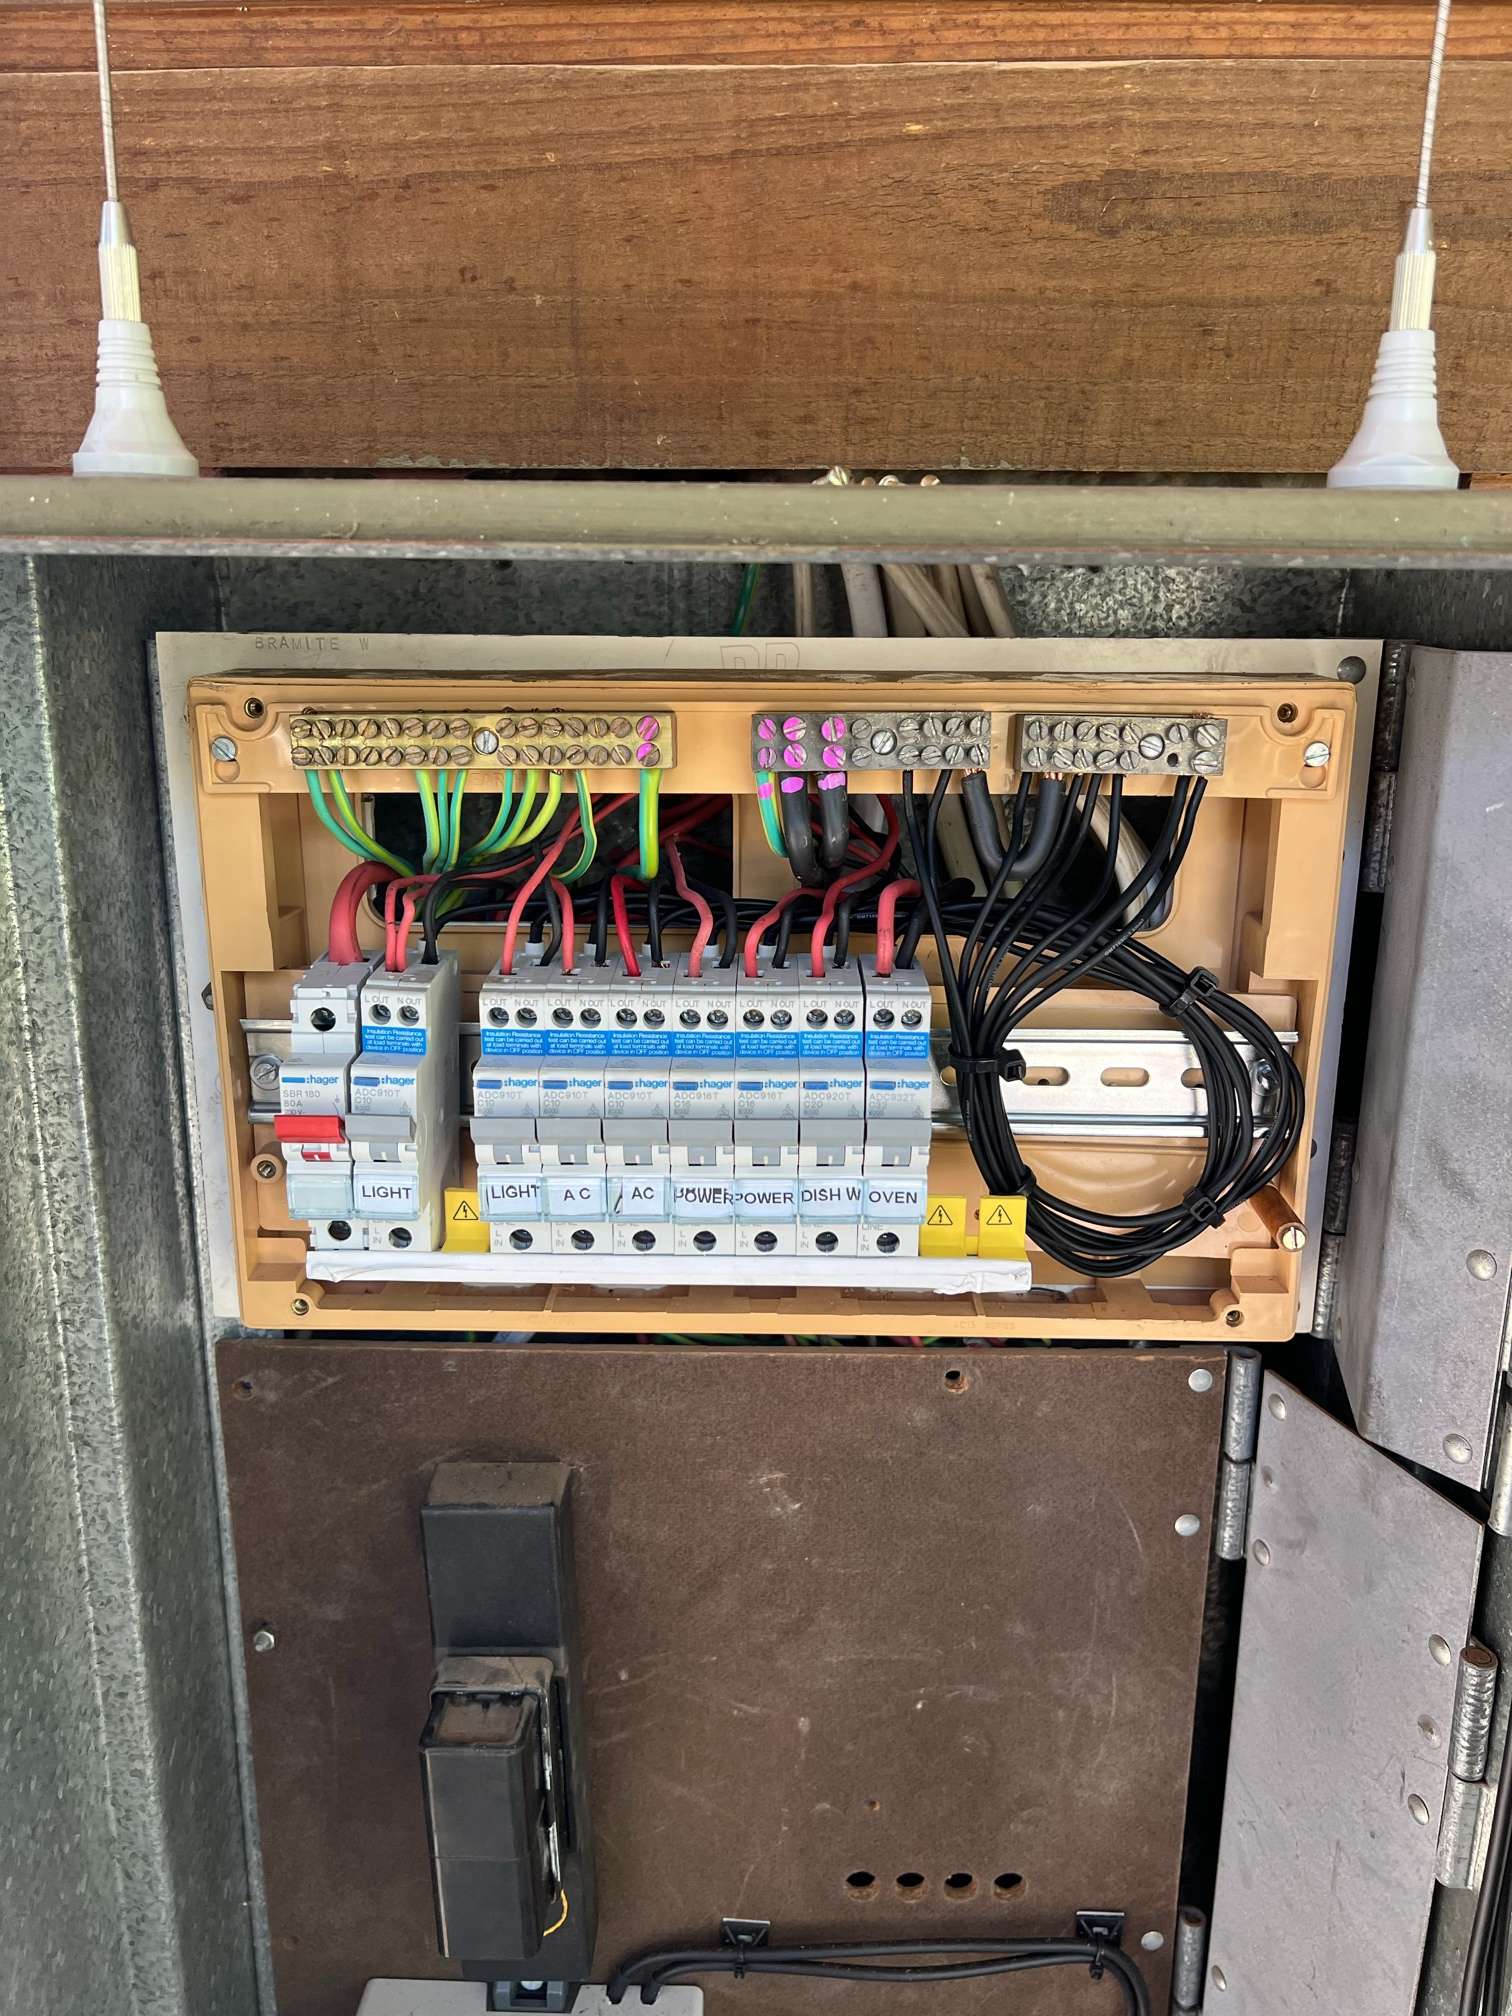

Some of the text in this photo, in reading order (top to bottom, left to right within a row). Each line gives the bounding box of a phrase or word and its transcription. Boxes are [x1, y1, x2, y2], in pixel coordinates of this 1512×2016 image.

[255, 636, 340, 650] BRAMITE
[362, 1184, 412, 1199] LIGHT
[491, 1184, 540, 1198] LIGHT
[631, 1187, 655, 1200] AC
[735, 1192, 795, 1204] POWER
[801, 1186, 861, 1202] DISH W
[869, 1191, 917, 1204] OVEN
